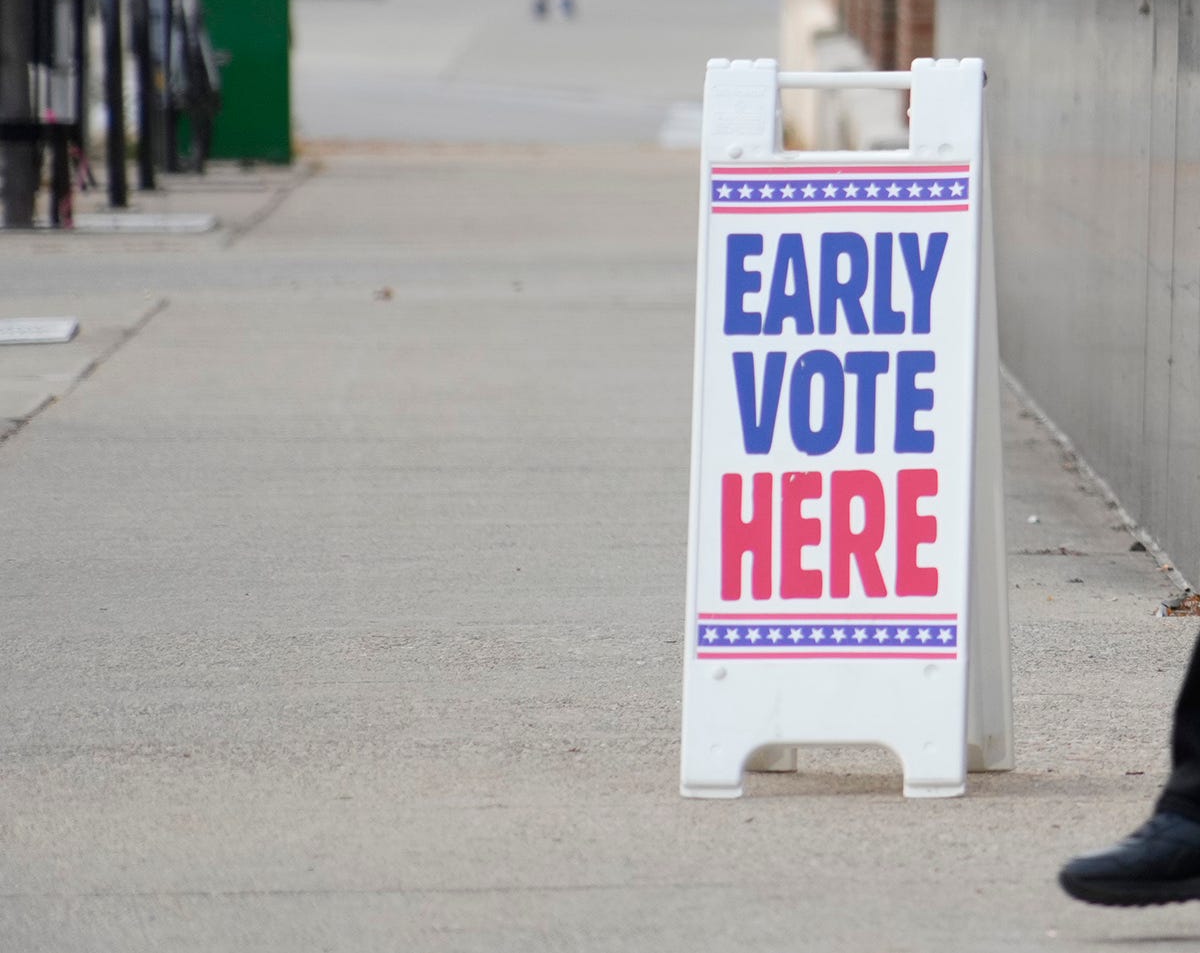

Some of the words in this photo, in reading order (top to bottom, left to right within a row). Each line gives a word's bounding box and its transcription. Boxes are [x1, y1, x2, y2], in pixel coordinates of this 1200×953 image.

[723, 231, 949, 336] EARLY
[732, 349, 936, 456] VOTE
[721, 468, 939, 601] HERE
